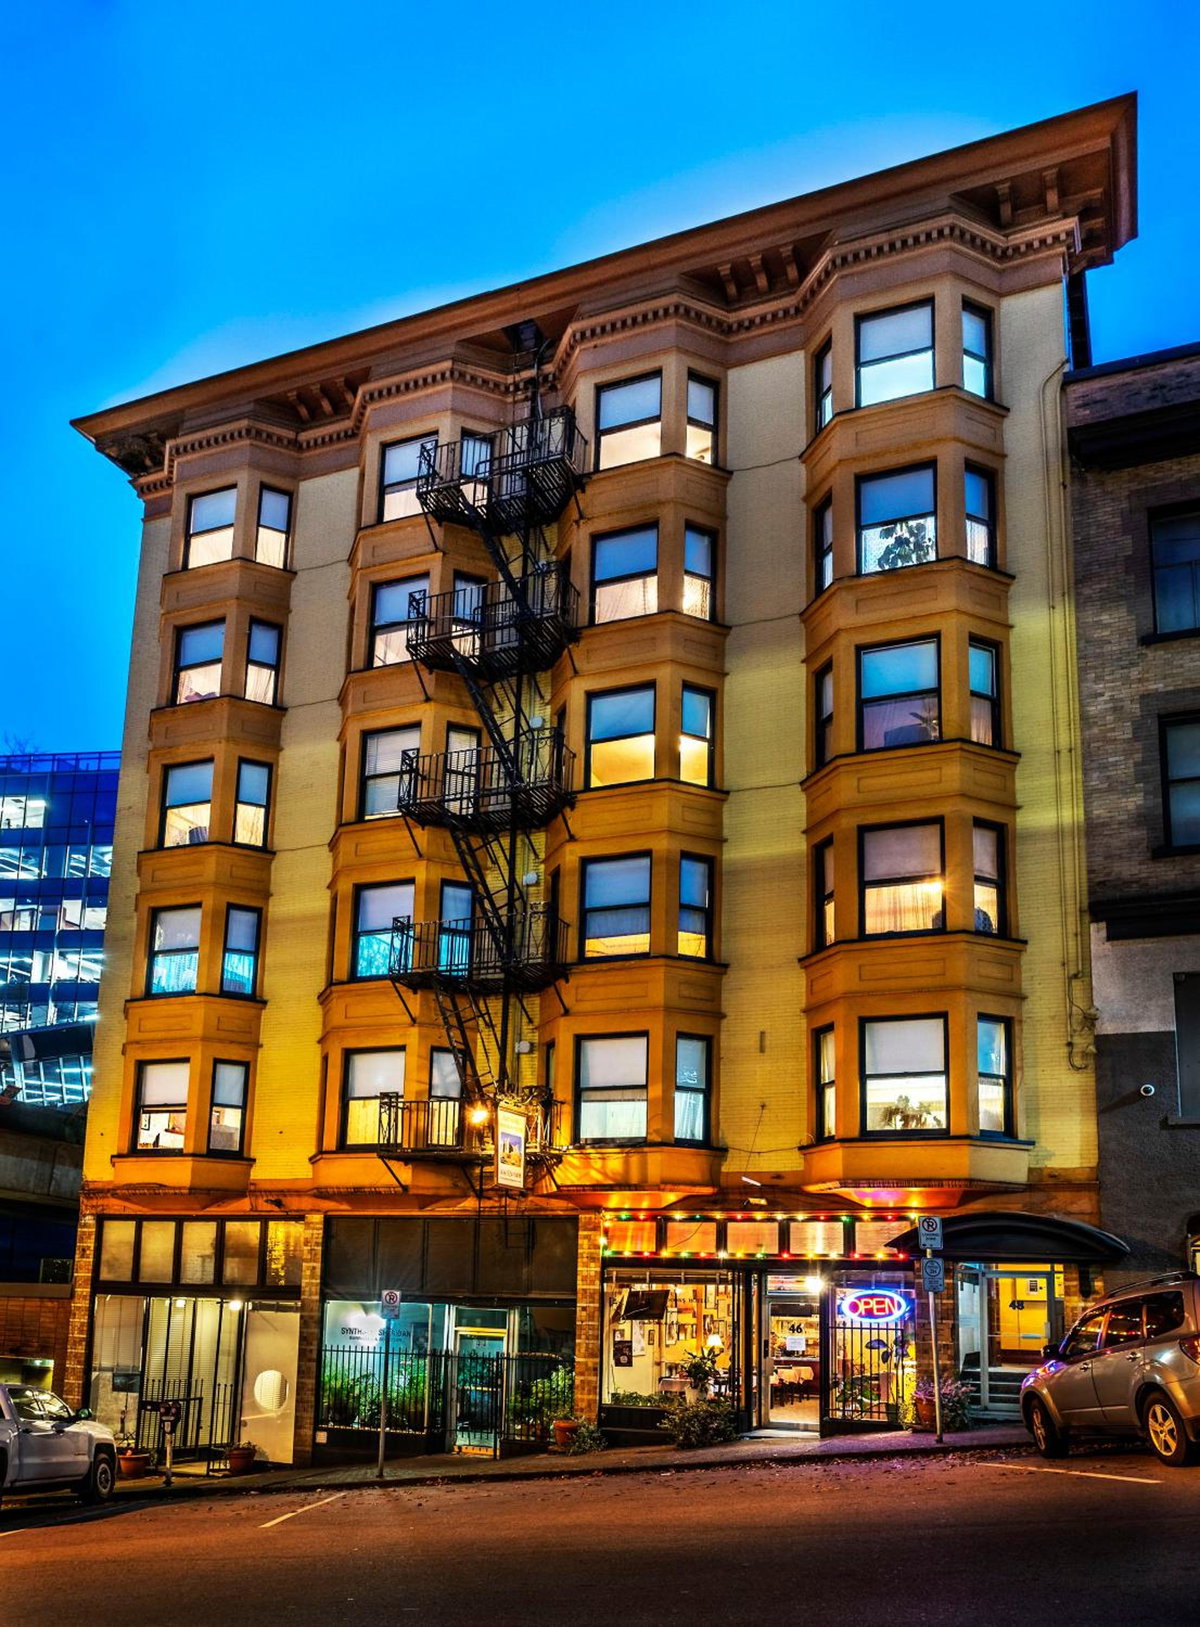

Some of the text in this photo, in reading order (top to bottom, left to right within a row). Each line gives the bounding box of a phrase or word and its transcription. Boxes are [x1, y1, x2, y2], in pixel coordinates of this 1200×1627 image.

[848, 1297, 899, 1316] OPEN
[1009, 1300, 1025, 1310] 48
[788, 1323, 804, 1334] 46
